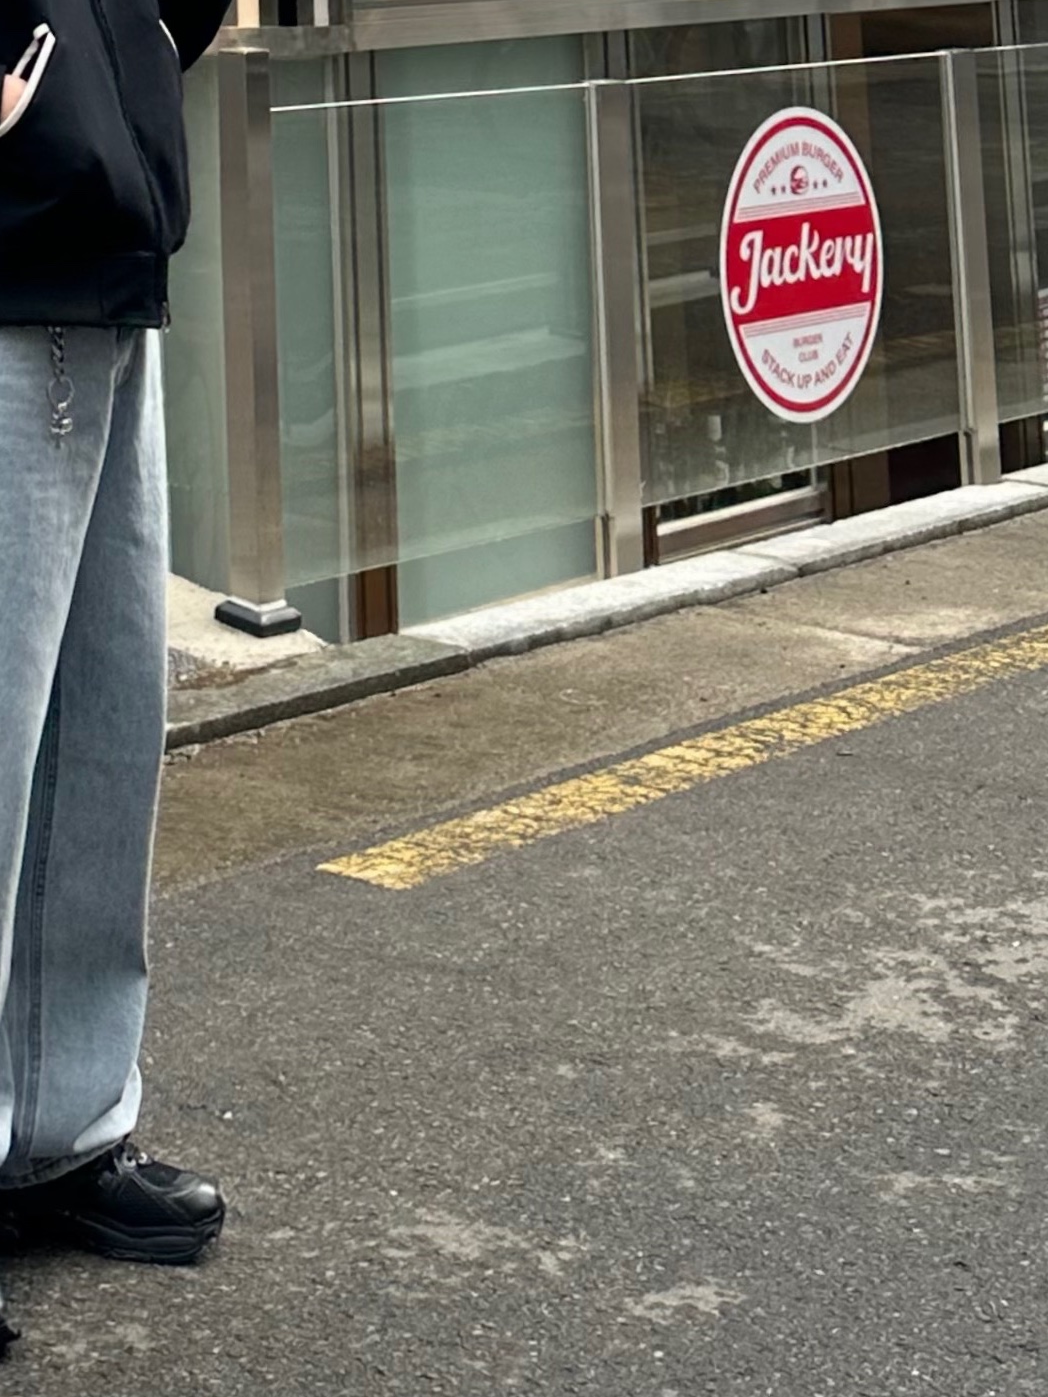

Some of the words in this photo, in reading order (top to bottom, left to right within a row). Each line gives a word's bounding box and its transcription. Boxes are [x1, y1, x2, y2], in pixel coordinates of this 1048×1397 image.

[753, 140, 800, 195] PREMIUM
[801, 140, 844, 183] BURGER
[730, 221, 874, 315] Jackery
[761, 348, 796, 388] STACK
[797, 373, 813, 389] UP
[814, 359, 837, 387] AND
[835, 331, 853, 366] EAT
